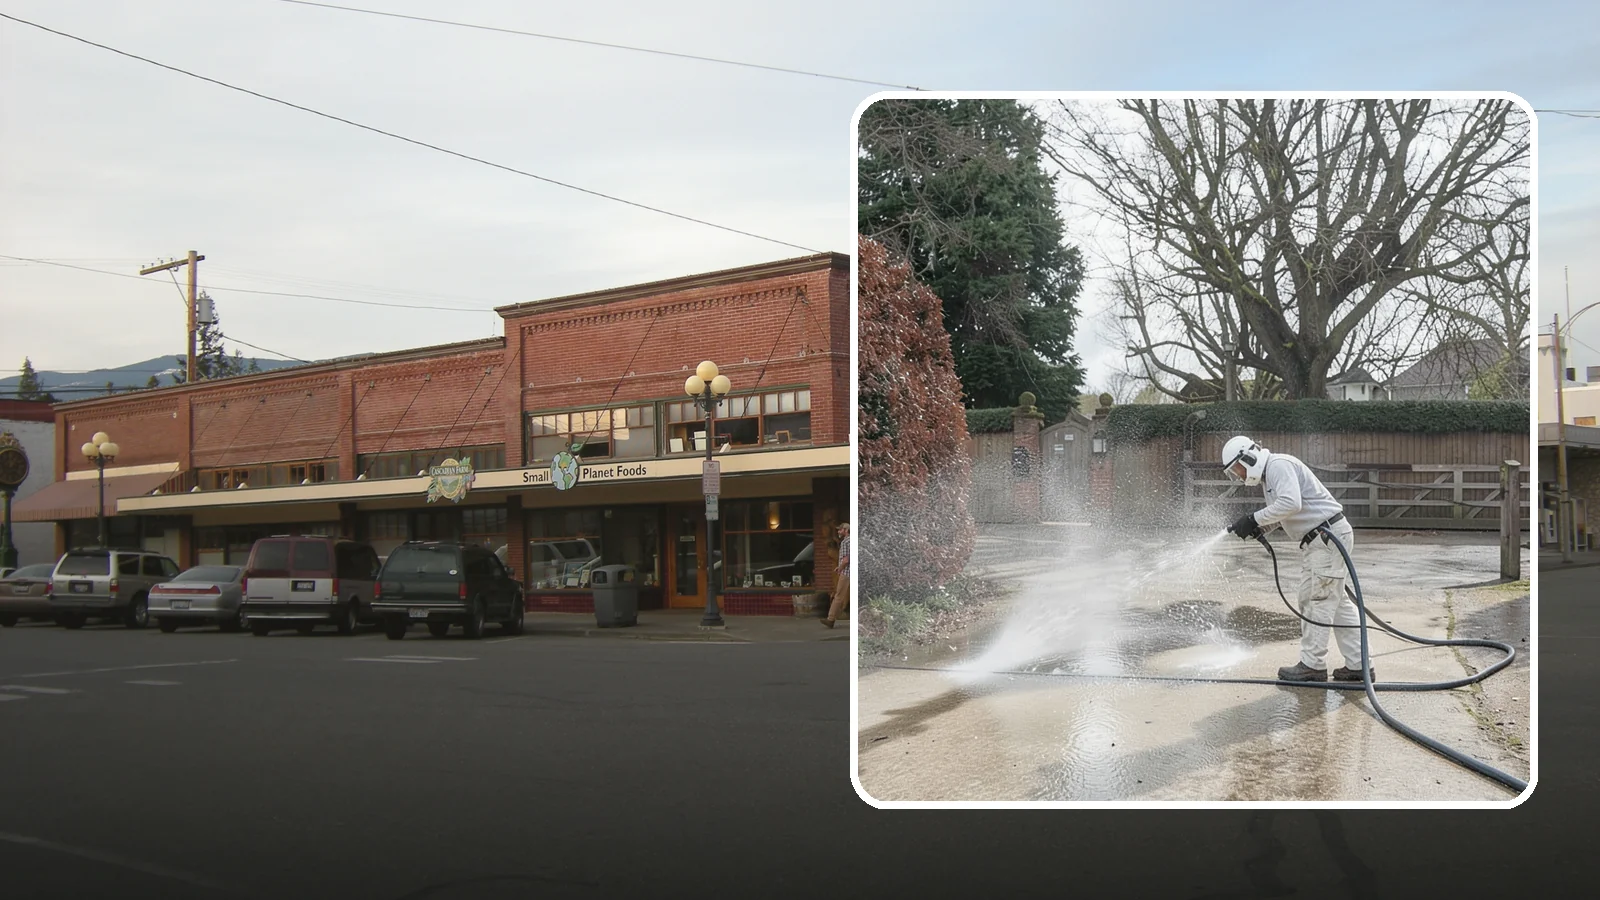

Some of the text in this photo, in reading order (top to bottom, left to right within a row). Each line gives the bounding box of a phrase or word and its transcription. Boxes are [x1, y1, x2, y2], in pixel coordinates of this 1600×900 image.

[523, 464, 647, 483] Small Planet Foods
